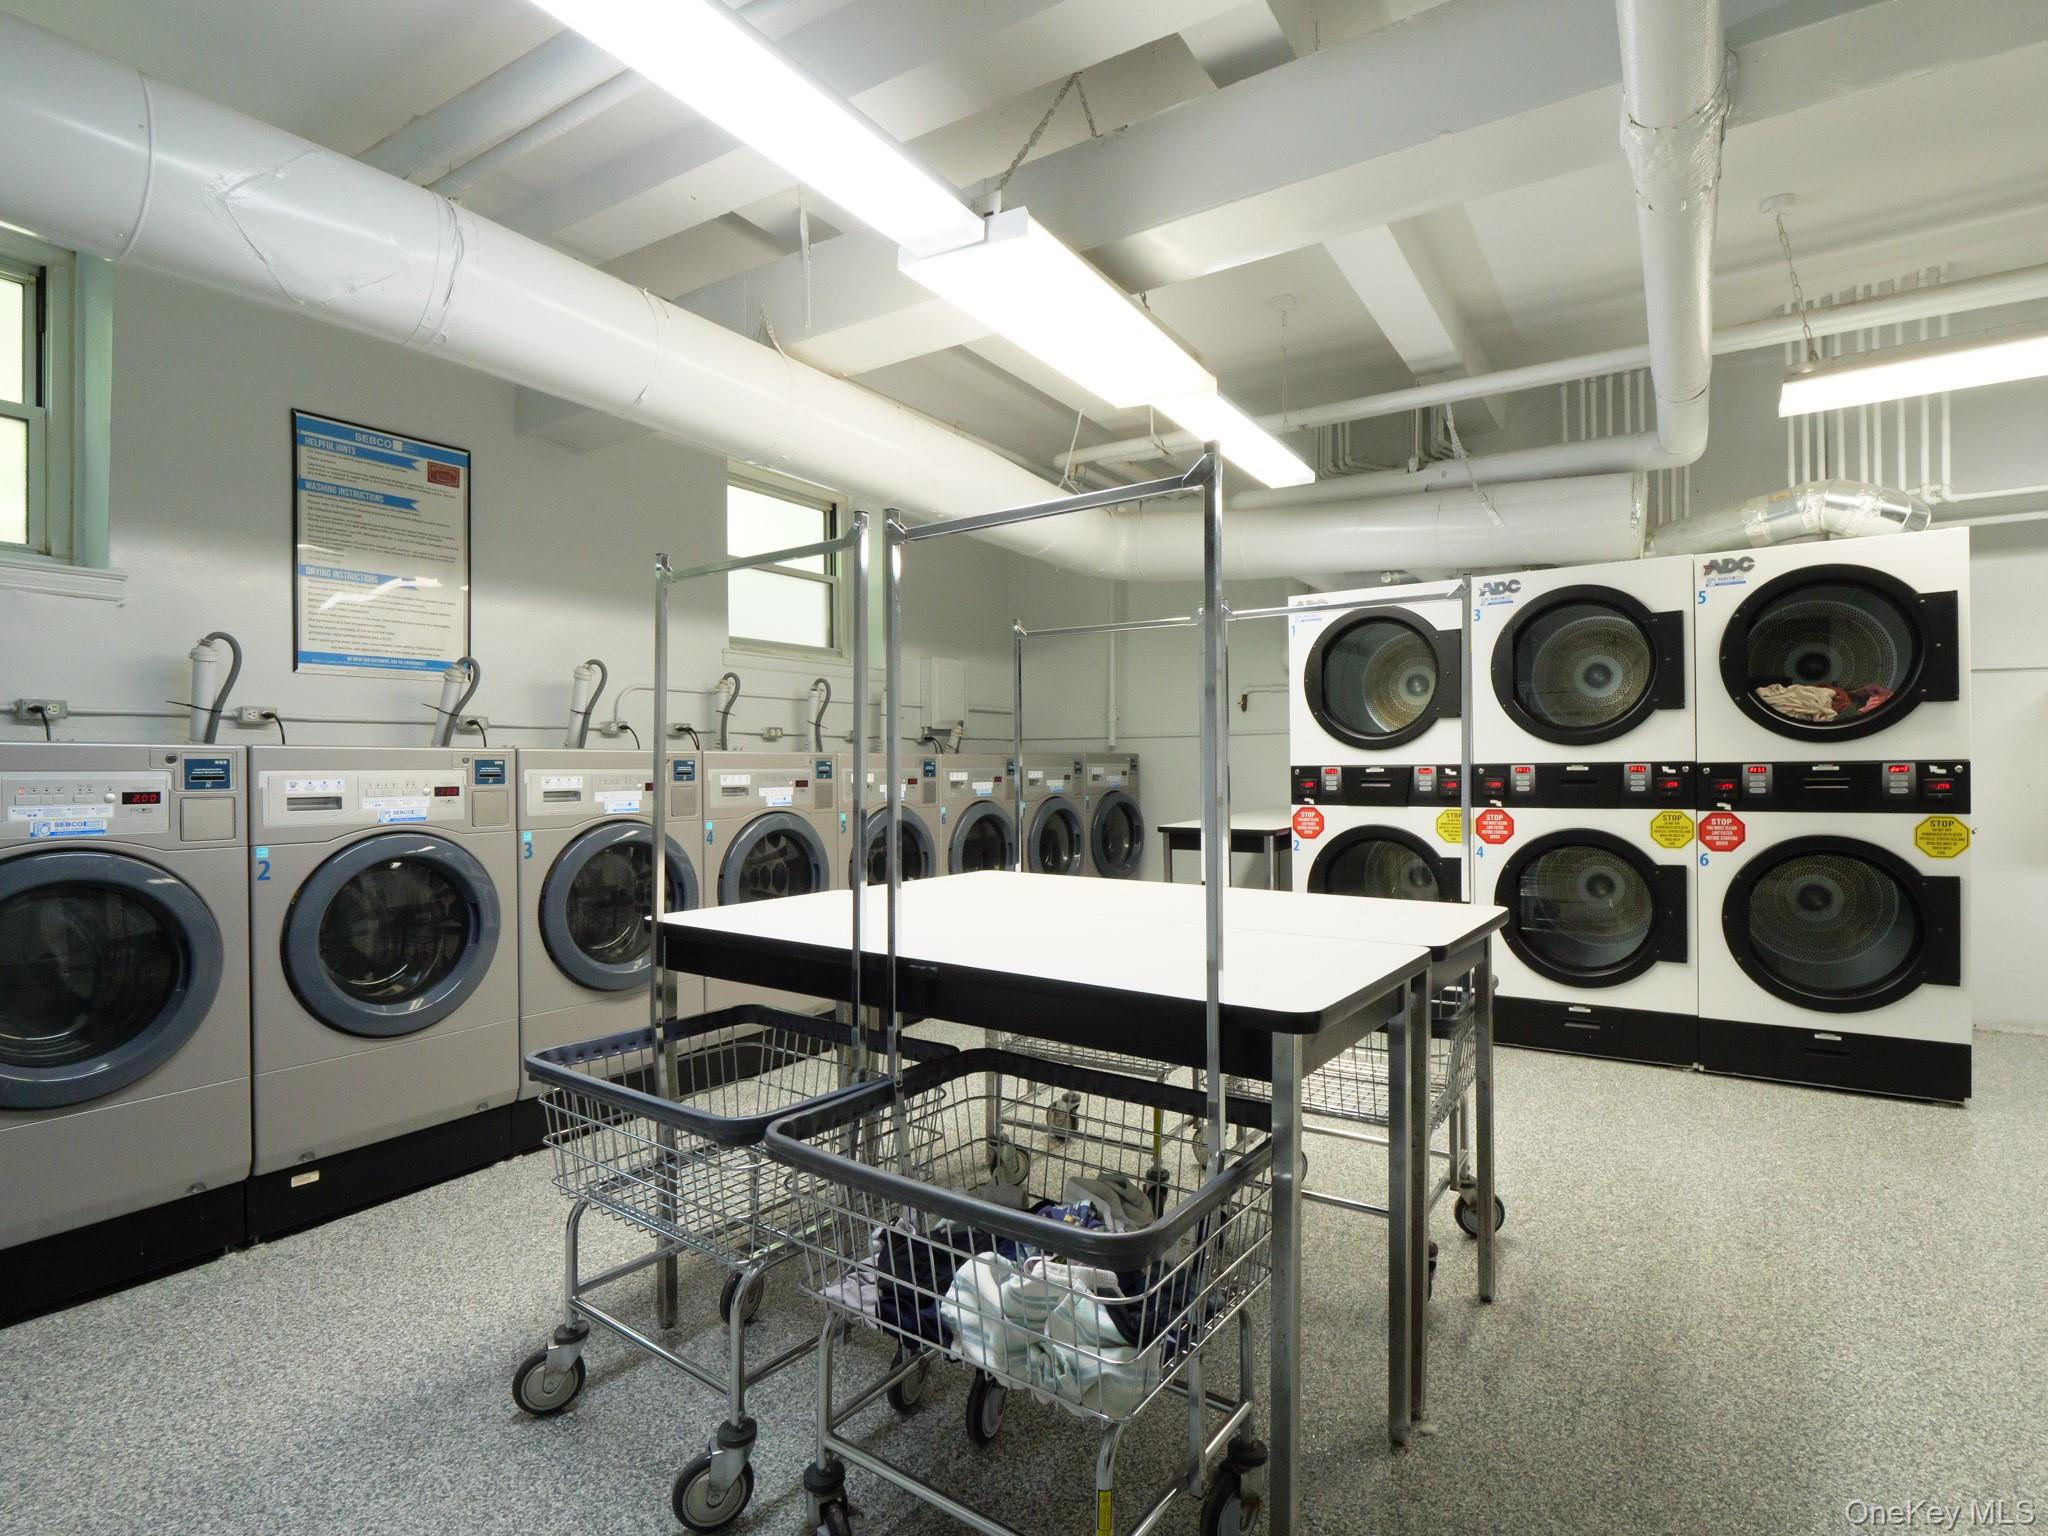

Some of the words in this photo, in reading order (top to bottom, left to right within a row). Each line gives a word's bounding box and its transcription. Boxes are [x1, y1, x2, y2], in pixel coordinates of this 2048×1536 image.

[305, 437, 333, 451] HELPFUL
[335, 444, 356, 455] HINTS
[354, 432, 392, 449] SEBCO
[305, 481, 337, 496] WASHING
[338, 487, 384, 503] INSTRUCTIONS
[1703, 556, 1755, 576] ADC
[305, 566, 332, 577] DRYING
[333, 569, 379, 583] INSTRUCTIONS
[1478, 579, 1521, 597] ADC
[1697, 590, 1706, 604] 5
[1474, 609, 1481, 621] 3
[840, 820, 846, 833] 5
[1930, 820, 1955, 828] STOP
[705, 831, 714, 845] 4
[523, 842, 533, 860] 3
[1293, 840, 1300, 852] 2
[1476, 846, 1484, 858] 4
[1700, 852, 1709, 866] 6
[257, 860, 271, 880] 2
